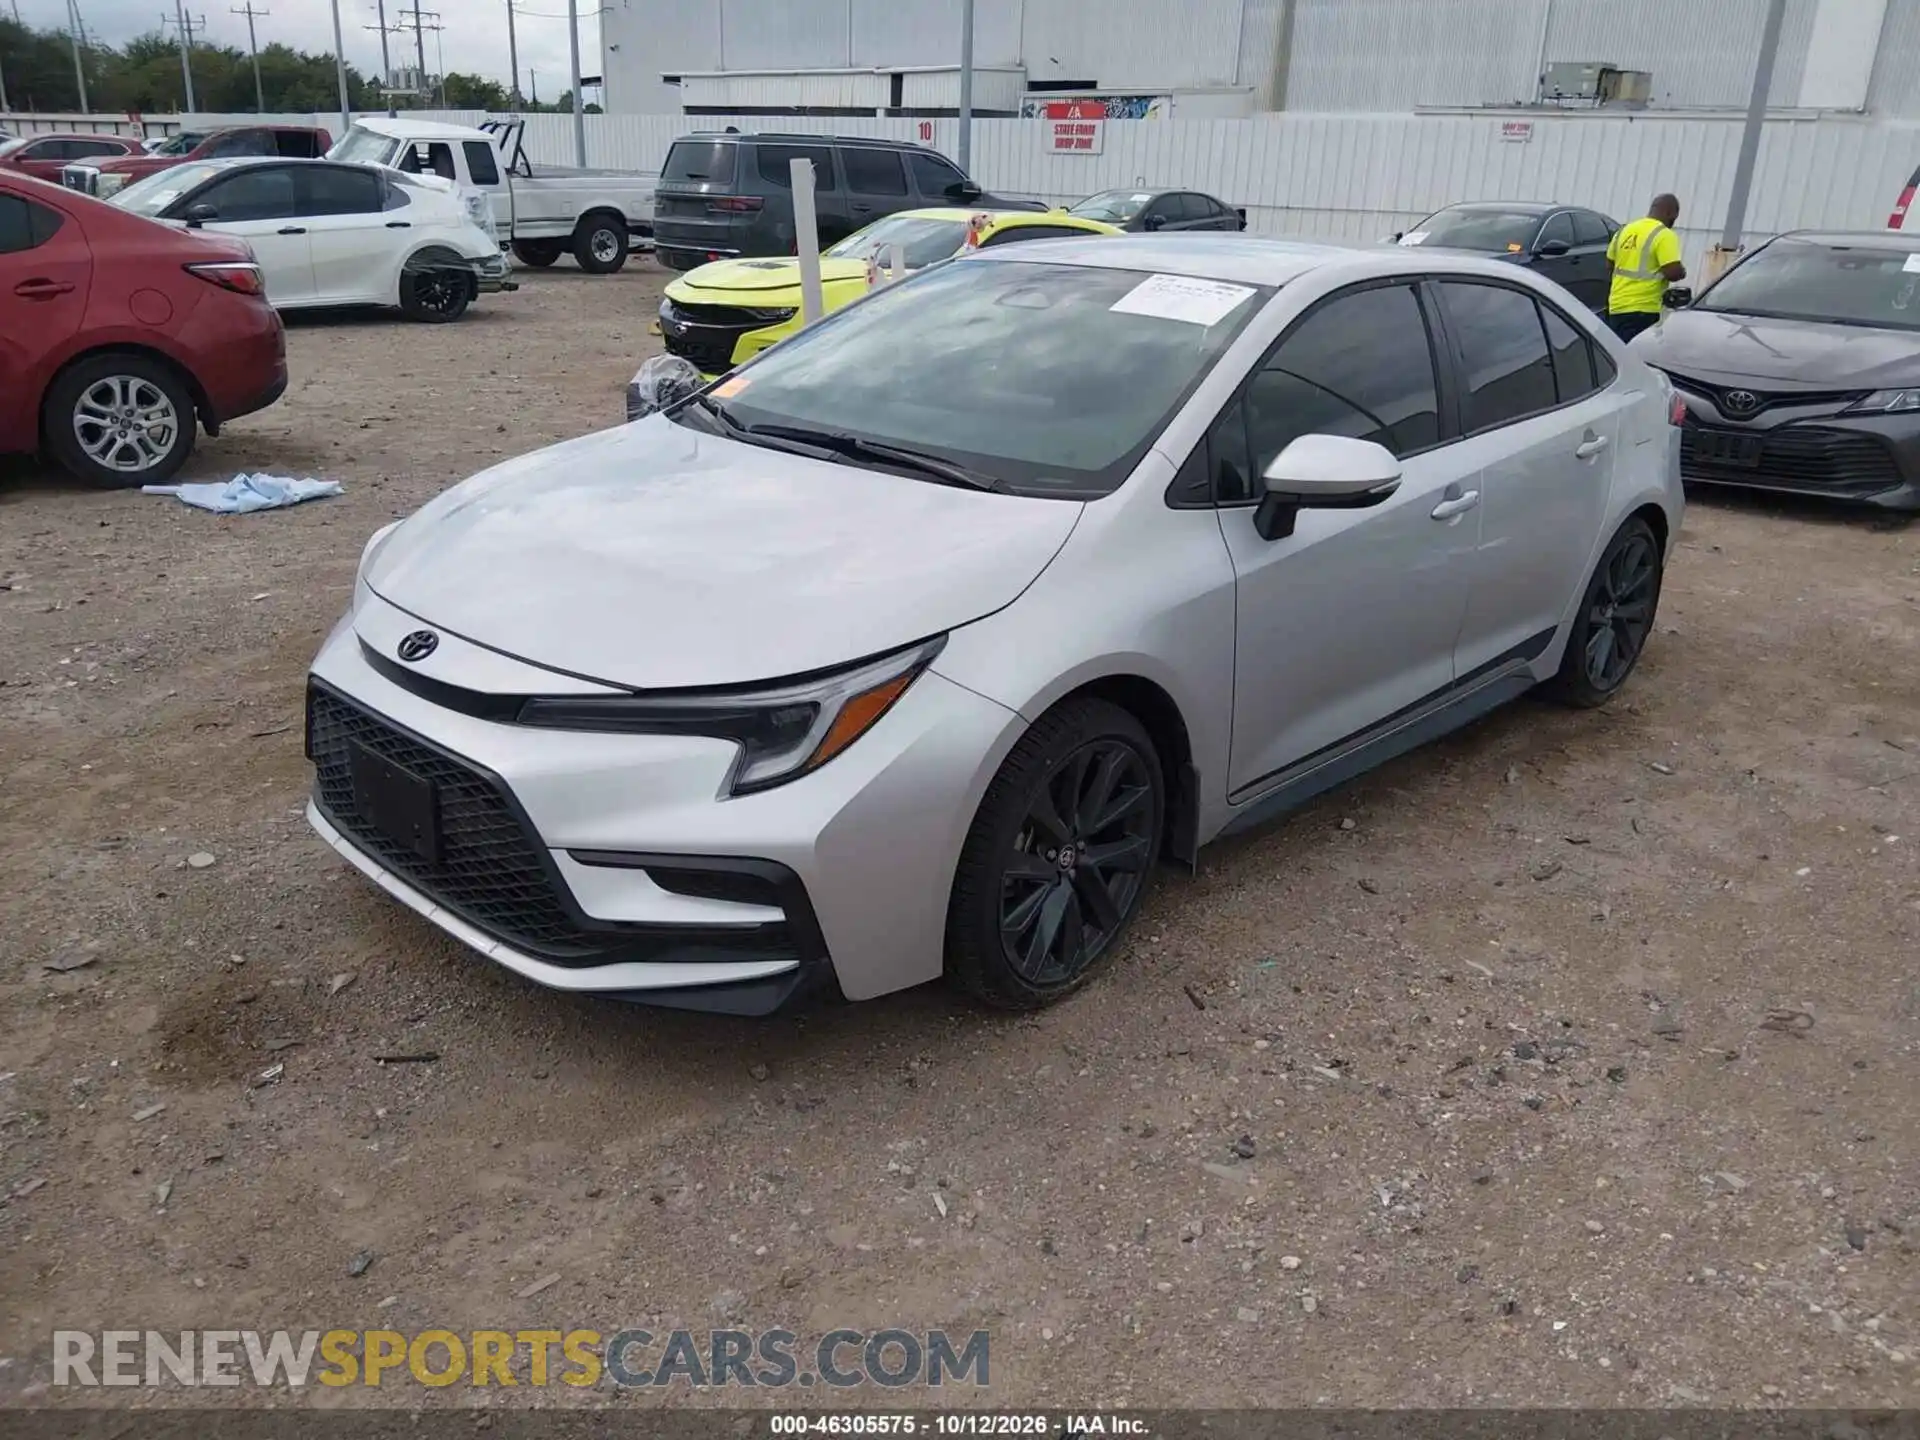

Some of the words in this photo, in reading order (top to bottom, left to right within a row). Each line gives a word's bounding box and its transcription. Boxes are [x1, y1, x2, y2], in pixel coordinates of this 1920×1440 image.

[918, 121, 932, 141] 10
[1054, 123, 1074, 136] STATE
[1073, 138, 1093, 150] ZONE
